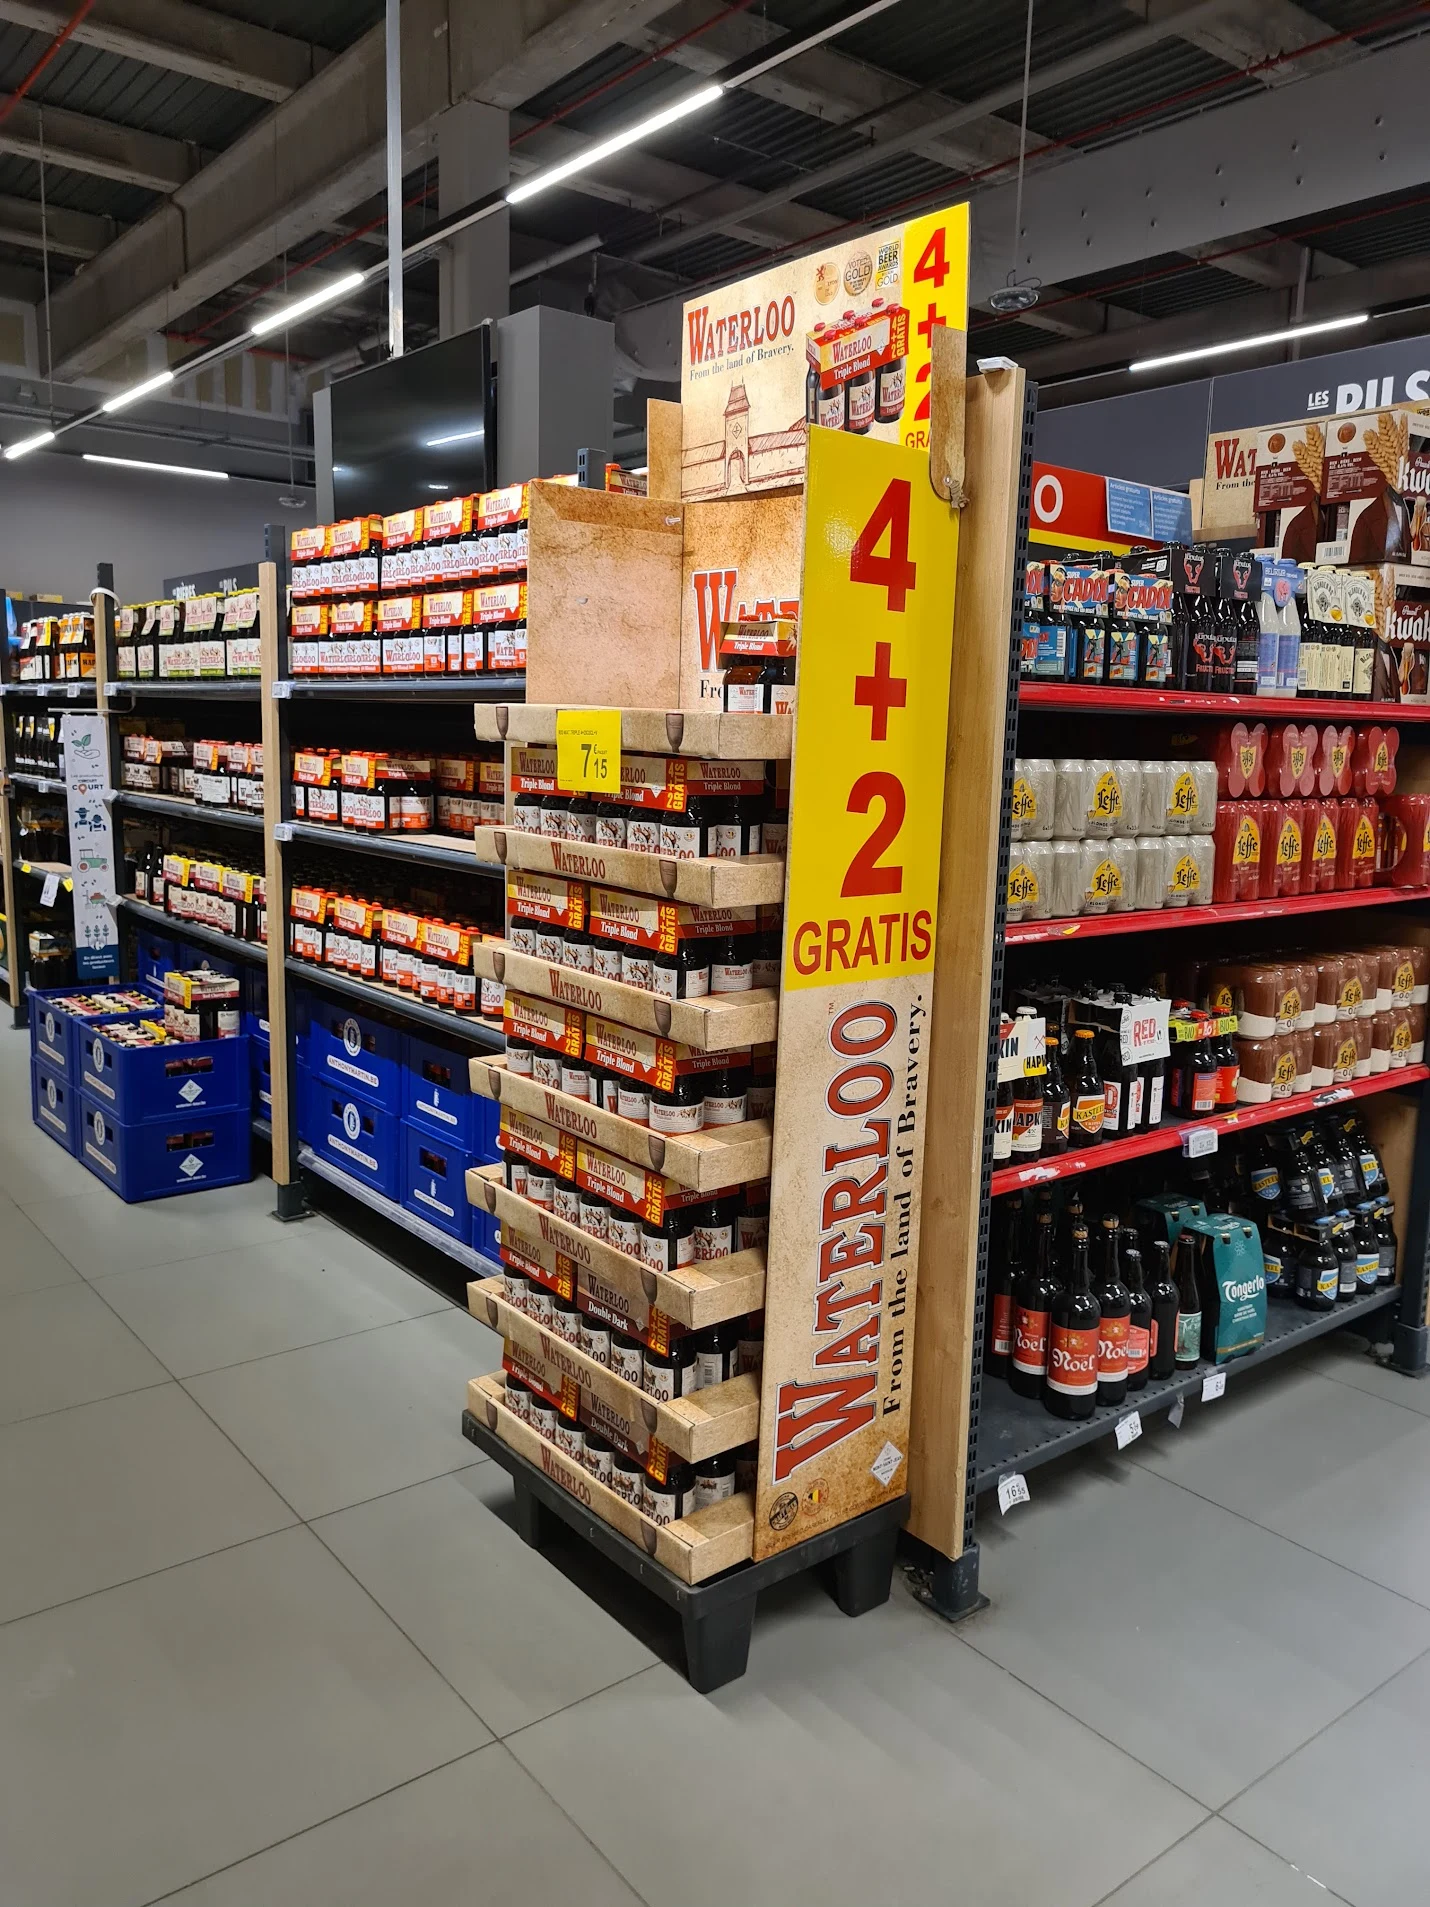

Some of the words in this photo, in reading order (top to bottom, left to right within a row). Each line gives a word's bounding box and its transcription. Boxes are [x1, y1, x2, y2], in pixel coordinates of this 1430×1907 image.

[878, 243, 899, 255] WORLD
[878, 250, 898, 265] BEER
[913, 227, 950, 289] 4
[845, 265, 871, 282] GOLD
[877, 273, 899, 288] GOLD
[878, 261, 898, 272] AWARDS
[687, 295, 796, 366] WATERLOO
[896, 313, 906, 357] GRATIS
[689, 365, 711, 382] From
[711, 359, 725, 375] the
[726, 354, 744, 372] land
[745, 351, 756, 367] of
[757, 342, 795, 365] Bravery.
[832, 335, 872, 364] WATERLOO
[833, 365, 853, 380] Triple
[853, 355, 871, 371] Blond
[1307, 390, 1330, 408] LES
[1216, 480, 1239, 491] From
[429, 509, 452, 525] WATERLOO
[485, 496, 511, 514] WATERLOO
[849, 477, 917, 613] 4
[480, 592, 507, 609] WATERLOO
[1063, 578, 1109, 604] CADIX
[1127, 585, 1173, 610] CADIX
[429, 597, 452, 614] WATERLOO
[734, 641, 749, 652] Triple
[748, 642, 765, 652] Blond
[854, 641, 908, 742] +
[519, 751, 555, 774] WATERLOO
[580, 743, 592, 778] 7
[593, 744, 598, 755] €
[593, 757, 608, 779] 15
[700, 762, 741, 779] WATERLOO
[520, 778, 538, 792] Triple
[538, 779, 555, 791] Blond
[625, 789, 644, 802] Blond
[673, 763, 685, 810] GRATIS
[703, 782, 723, 792] Triple
[723, 781, 741, 791] Blond
[1097, 789, 1120, 814] Leffe
[1175, 787, 1197, 814] Leffe
[840, 770, 907, 899] 2
[1237, 834, 1258, 859] Leffe
[1281, 834, 1300, 860] Leffe
[1316, 833, 1334, 858] Leffe
[1356, 831, 1373, 856] Leffe
[550, 842, 606, 880] WATERLOO
[516, 875, 552, 902] WATERLOO
[1010, 876, 1035, 899] Leffe
[1096, 873, 1119, 896] Leffe
[1176, 869, 1197, 891] Leffe
[517, 901, 534, 914] Triple
[533, 905, 550, 918] Blond
[573, 886, 583, 929] GRATIS
[600, 893, 640, 923] WATERLOO
[690, 906, 733, 923] WATERLOO
[427, 926, 450, 947] WATERLOO
[601, 921, 620, 936] Triple
[620, 927, 639, 941] Blond
[664, 907, 676, 953] GRATIS
[695, 925, 714, 935] Triple
[715, 924, 733, 933] Blond
[792, 909, 933, 976] GRATIS
[549, 968, 602, 1011] WATERLOO
[512, 997, 549, 1027] WATERLOO
[513, 1021, 531, 1037] Triple
[531, 1028, 547, 1042] Blond
[570, 1014, 581, 1056] GRATIS
[596, 1022, 637, 1057] WATERLOO
[1133, 1018, 1156, 1048] RED
[596, 1050, 616, 1067] Triple
[615, 1058, 635, 1073] Blond
[662, 1044, 674, 1091] GRATIS
[692, 1058, 711, 1069] Triple
[711, 1057, 730, 1066] Blond
[897, 994, 927, 1137] Bravery.
[544, 1091, 597, 1139] WATERLOO
[653, 1105, 676, 1118] WATERLOO
[508, 1111, 544, 1145] WATERLOO
[509, 1136, 526, 1151] Triple
[525, 1143, 542, 1160] Blond
[564, 1135, 575, 1180] GRATIS
[896, 1145, 914, 1178] of
[586, 1148, 627, 1187] WATERLOO
[586, 1175, 606, 1193] Triple
[606, 1186, 625, 1203] Blond
[651, 1178, 663, 1224] GRATIS
[681, 1192, 700, 1203] Triple
[890, 1188, 912, 1260] land
[507, 1225, 541, 1263] WATERLOO
[538, 1212, 591, 1265] WATERLOO
[772, 999, 899, 1486] WATERLOO
[560, 1257, 571, 1300] GRATIS
[1222, 1275, 1265, 1303] Tongerlo
[587, 1273, 630, 1314] WATERLOO
[888, 1268, 908, 1318] the
[588, 1300, 612, 1321] Double
[611, 1313, 629, 1331] Dark
[656, 1309, 669, 1354] GRATIS
[511, 1340, 546, 1378] WATERLOO
[539, 1332, 593, 1389] WATERLOO
[883, 1326, 905, 1418] From
[1052, 1347, 1096, 1372] Noël
[590, 1392, 631, 1435] WATERLOO
[590, 1416, 614, 1441] Double
[613, 1435, 629, 1452] Dark
[540, 1442, 592, 1506] WATERLOO
[1005, 1485, 1018, 1500] 16
